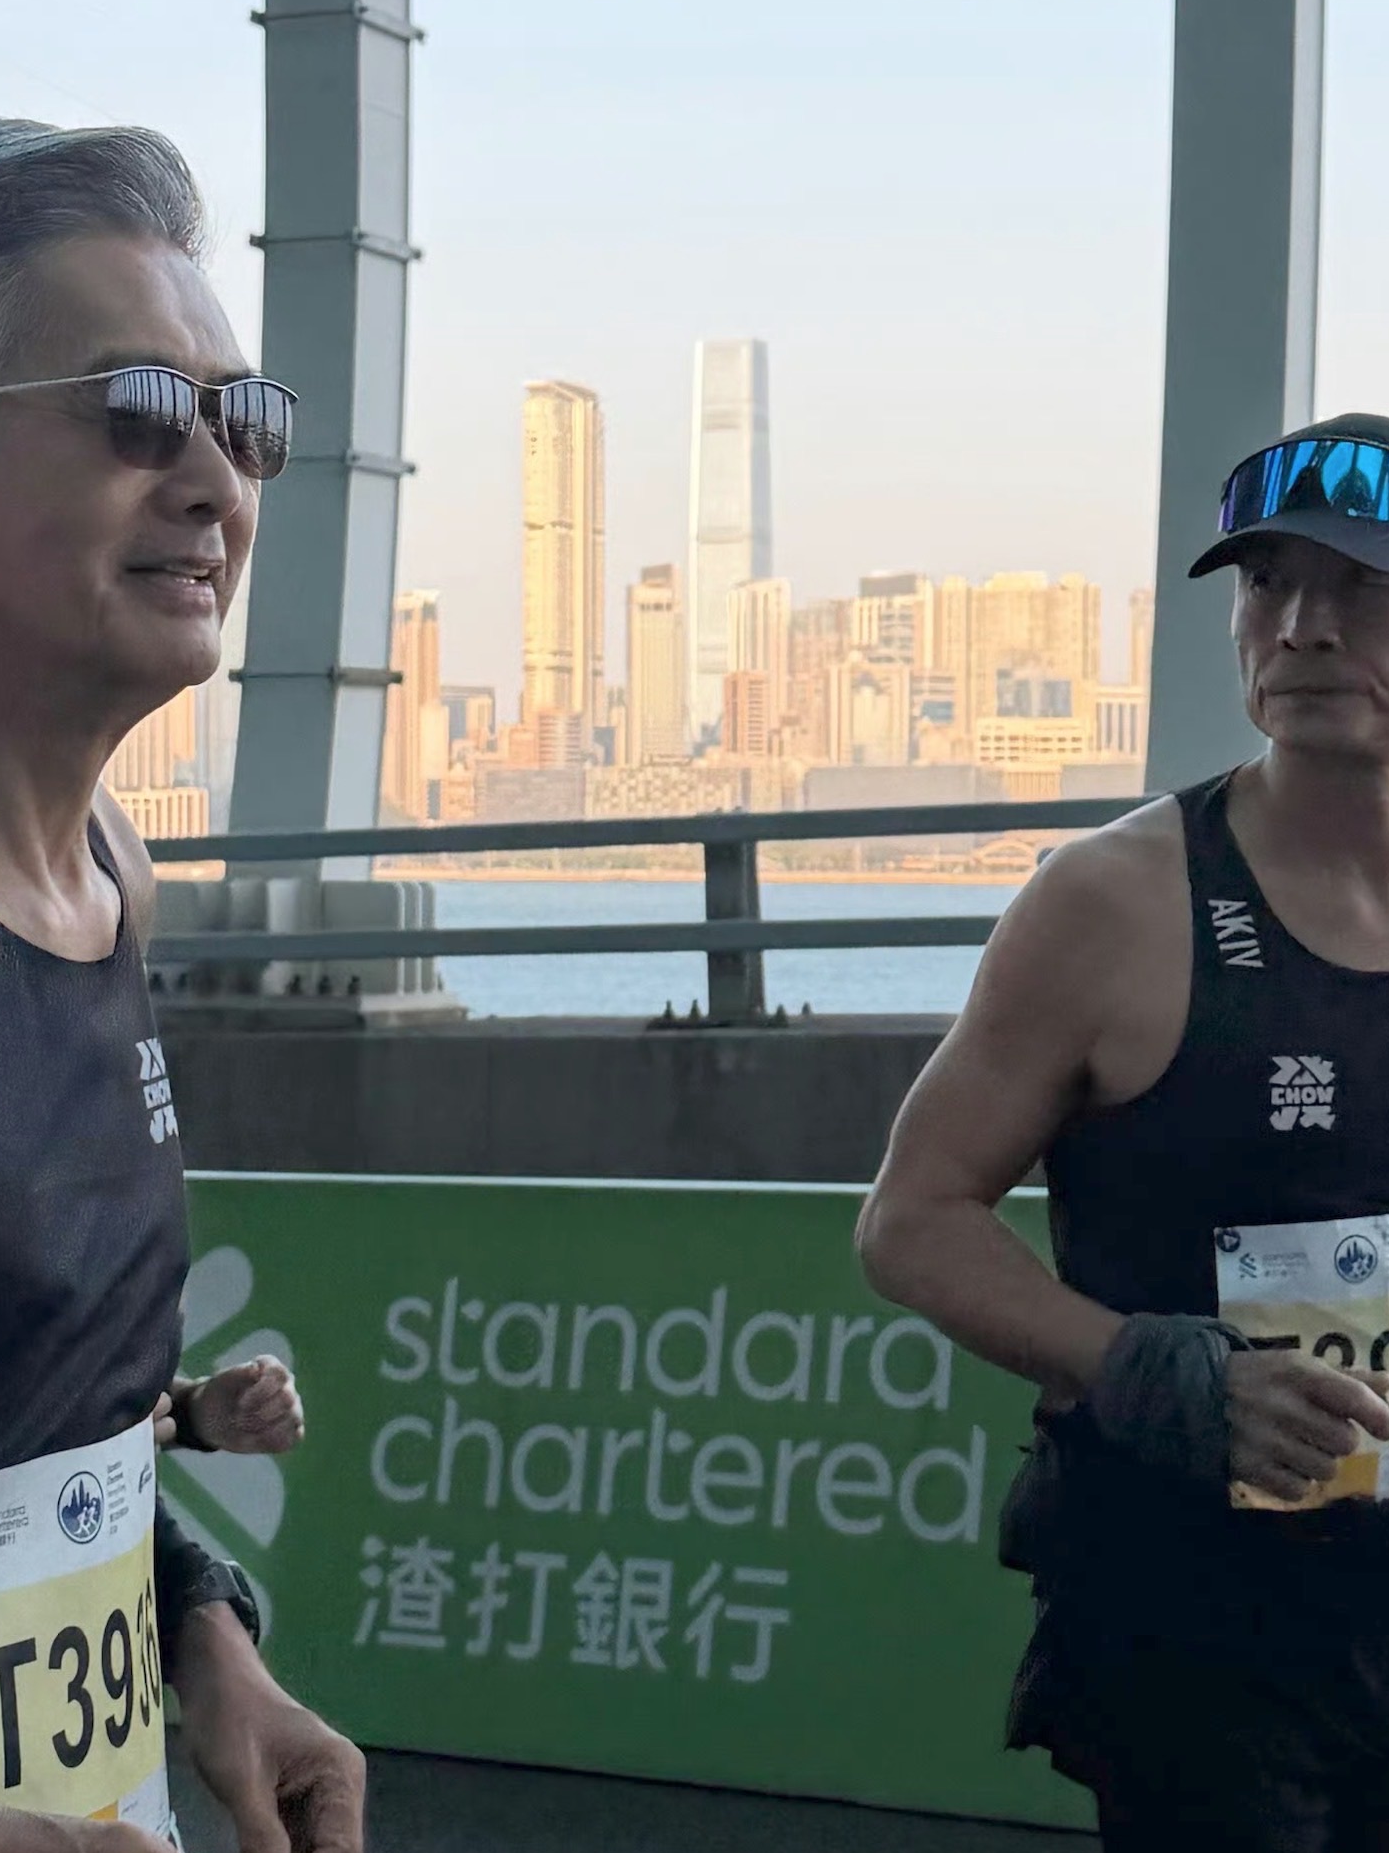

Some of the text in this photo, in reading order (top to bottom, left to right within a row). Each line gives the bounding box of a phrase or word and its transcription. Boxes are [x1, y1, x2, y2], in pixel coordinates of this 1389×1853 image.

[1208, 899, 1264, 968] AKIV
[1270, 1086, 1335, 1105] CHOW
[371, 1397, 987, 1545] chartered
[353, 1535, 793, 1684] 渣打銀行
